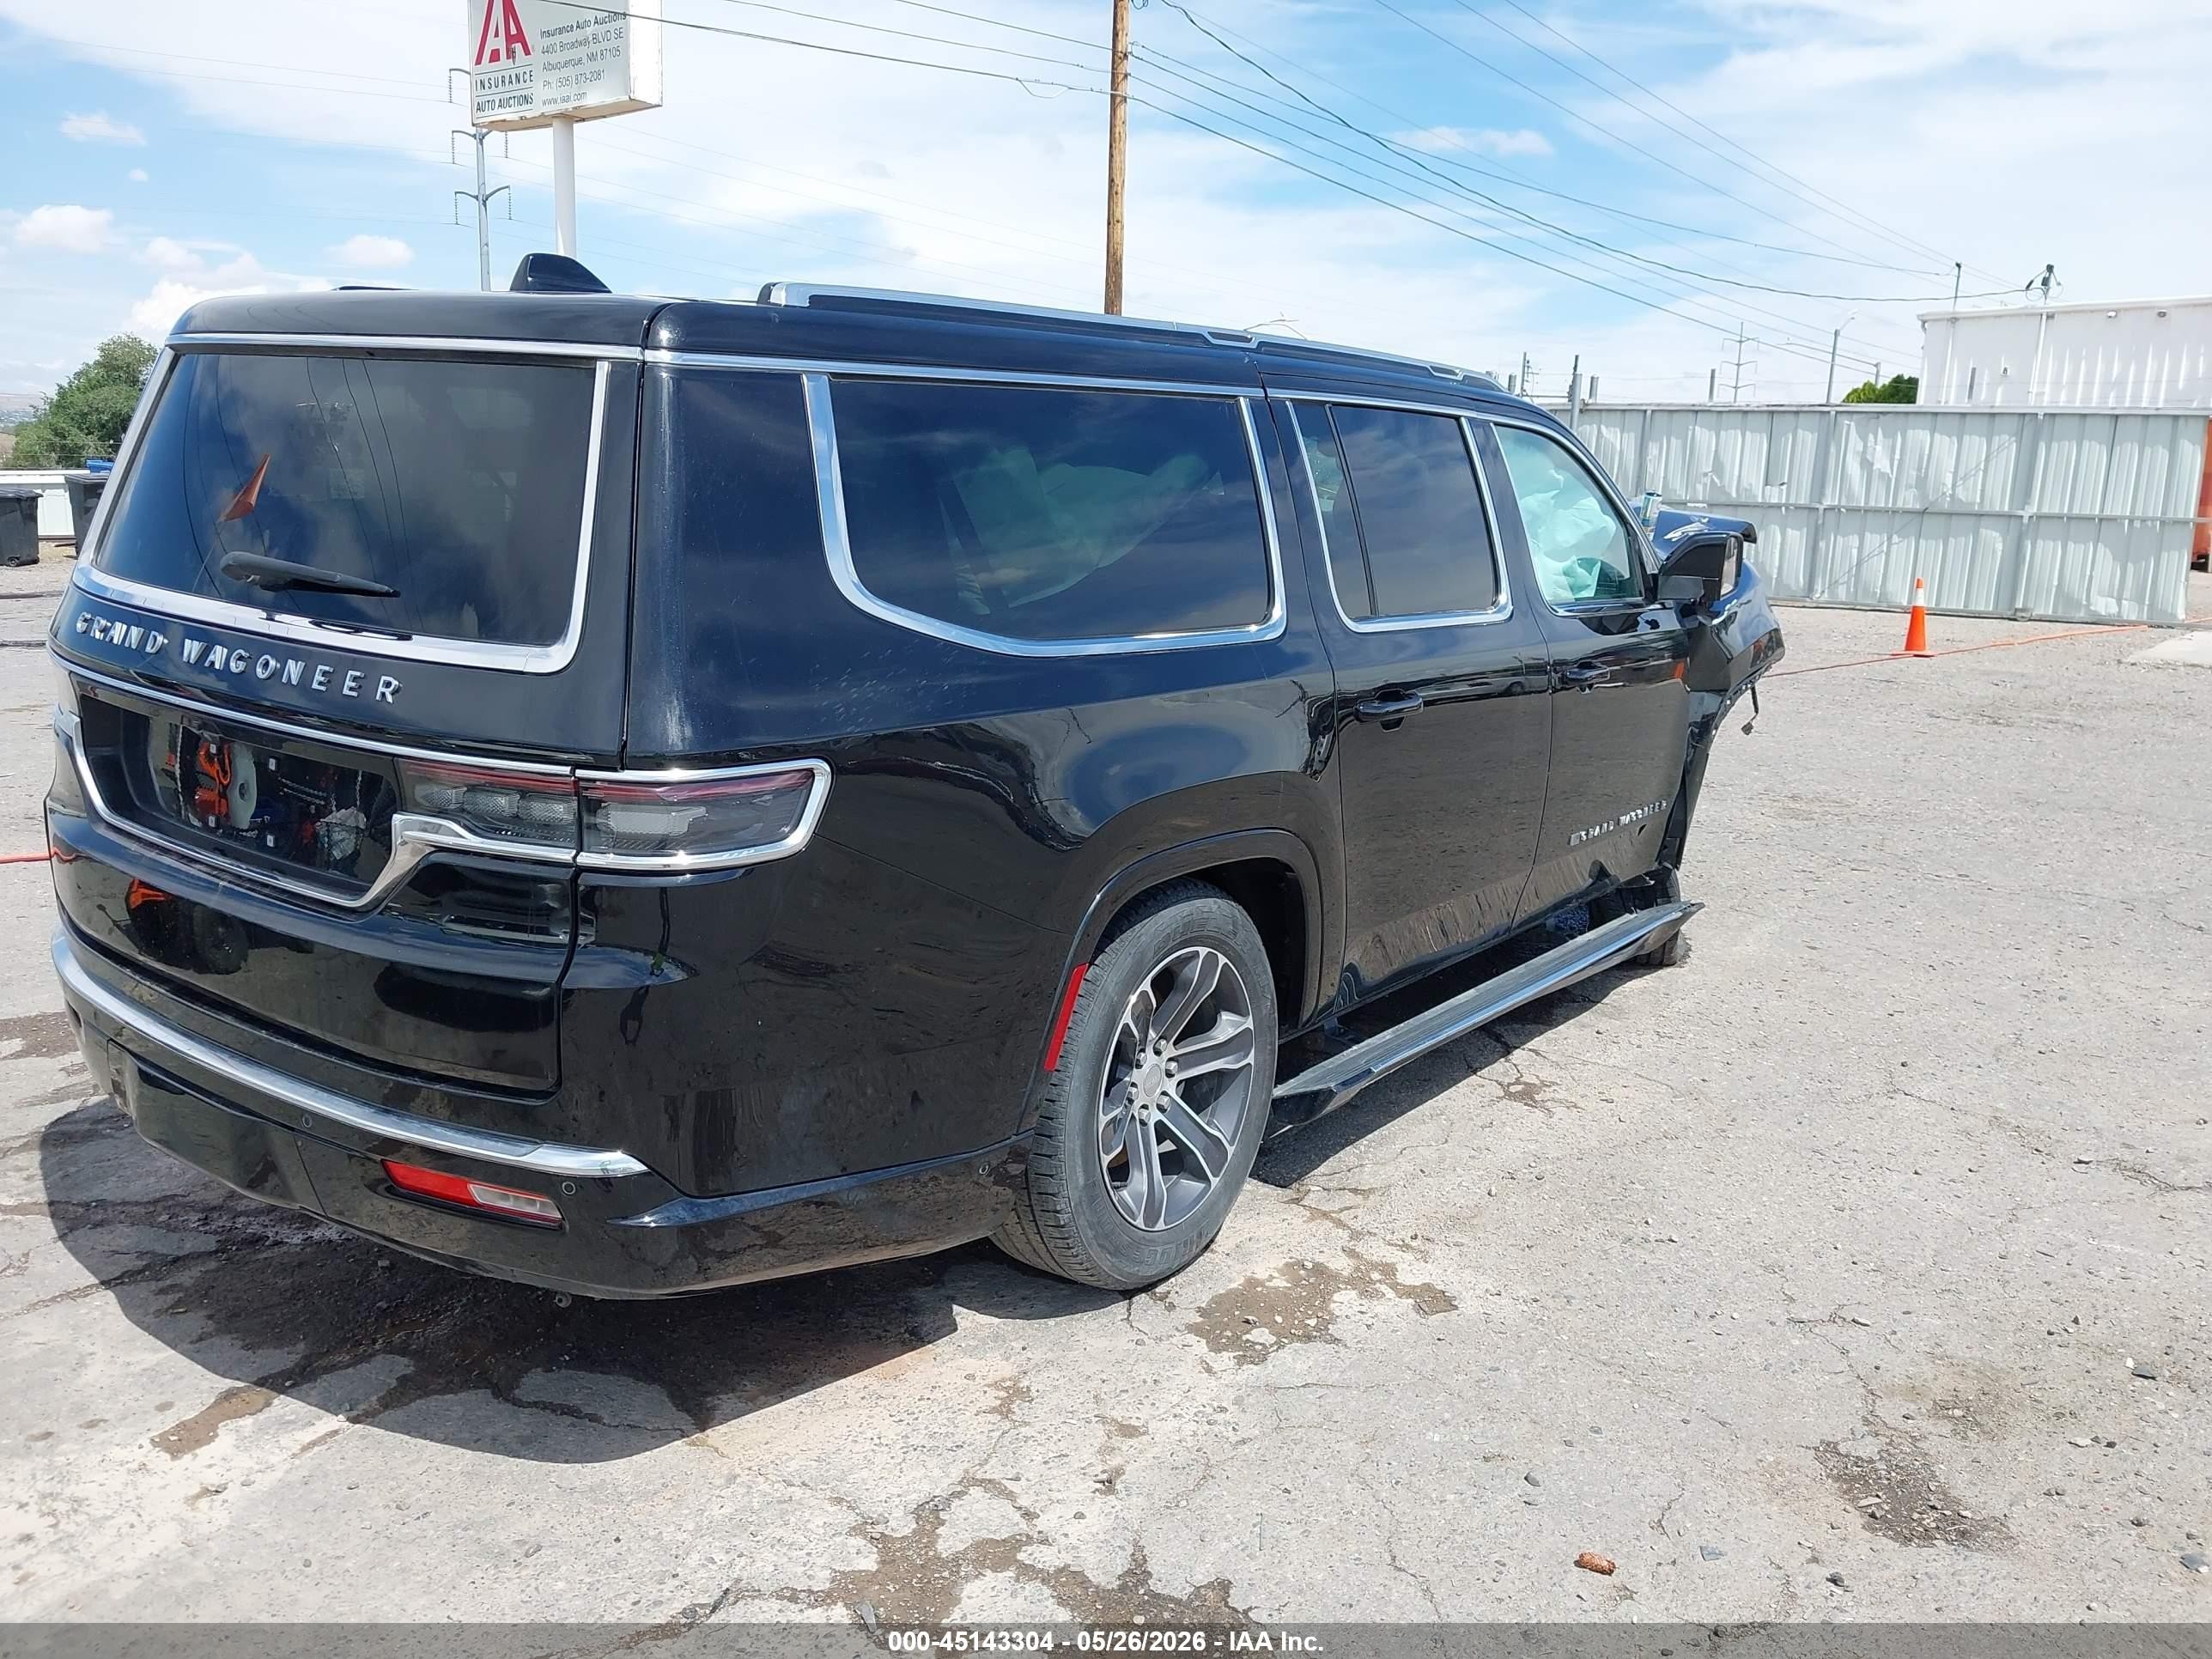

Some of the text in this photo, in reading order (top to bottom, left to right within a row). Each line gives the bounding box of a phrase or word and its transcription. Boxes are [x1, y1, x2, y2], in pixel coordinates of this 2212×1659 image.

[540, 11, 627, 40] Insurance Auto Auctions
[541, 27, 624, 56] 4400 Broadway BLVD SE
[542, 46, 621, 73] Albuquerque, NM 87105
[475, 70, 534, 92] INSURANCE
[543, 69, 605, 90] Ph: (505) 873-2081
[476, 93, 534, 113] AUTO AUCTIONS
[76, 611, 403, 704] GRAND WAGONEER
